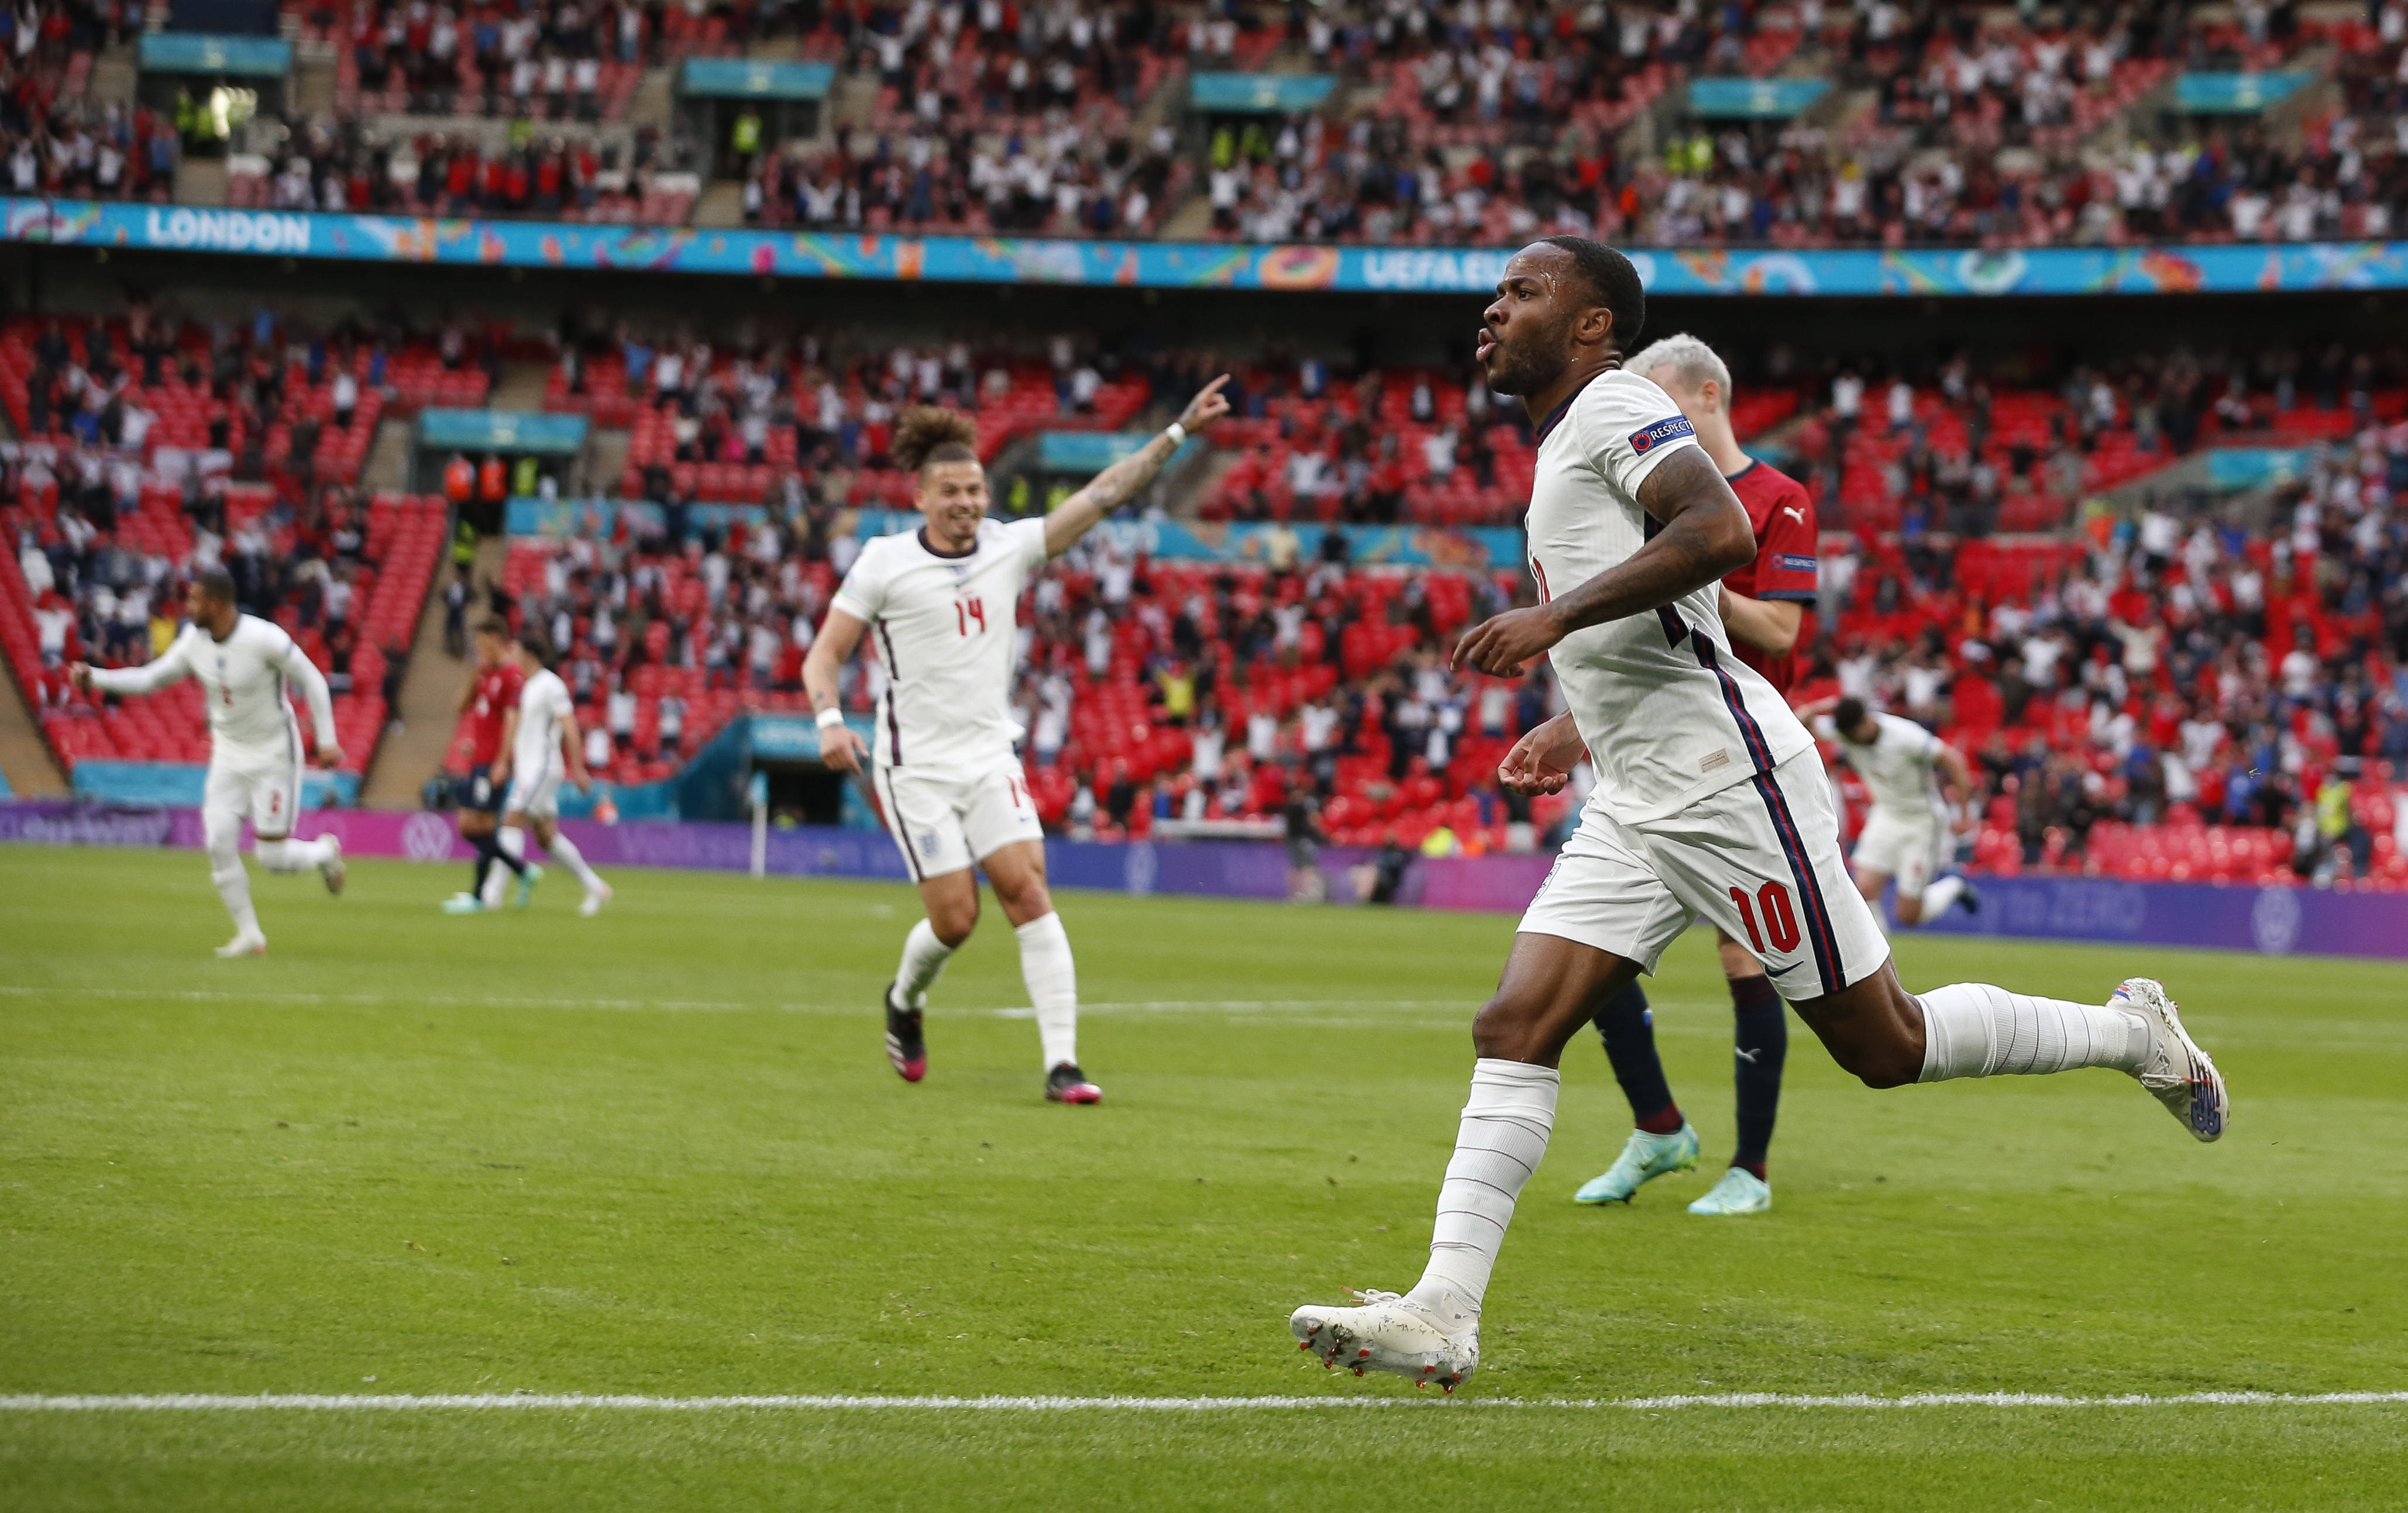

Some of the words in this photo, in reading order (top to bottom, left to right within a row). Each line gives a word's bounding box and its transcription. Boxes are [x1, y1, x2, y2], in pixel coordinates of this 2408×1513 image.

[146, 206, 311, 255] LONDON
[1363, 248, 1460, 289] UEFA
[1650, 420, 1690, 440] RESPECT
[954, 597, 986, 636] 14
[1729, 881, 1801, 953] 10
